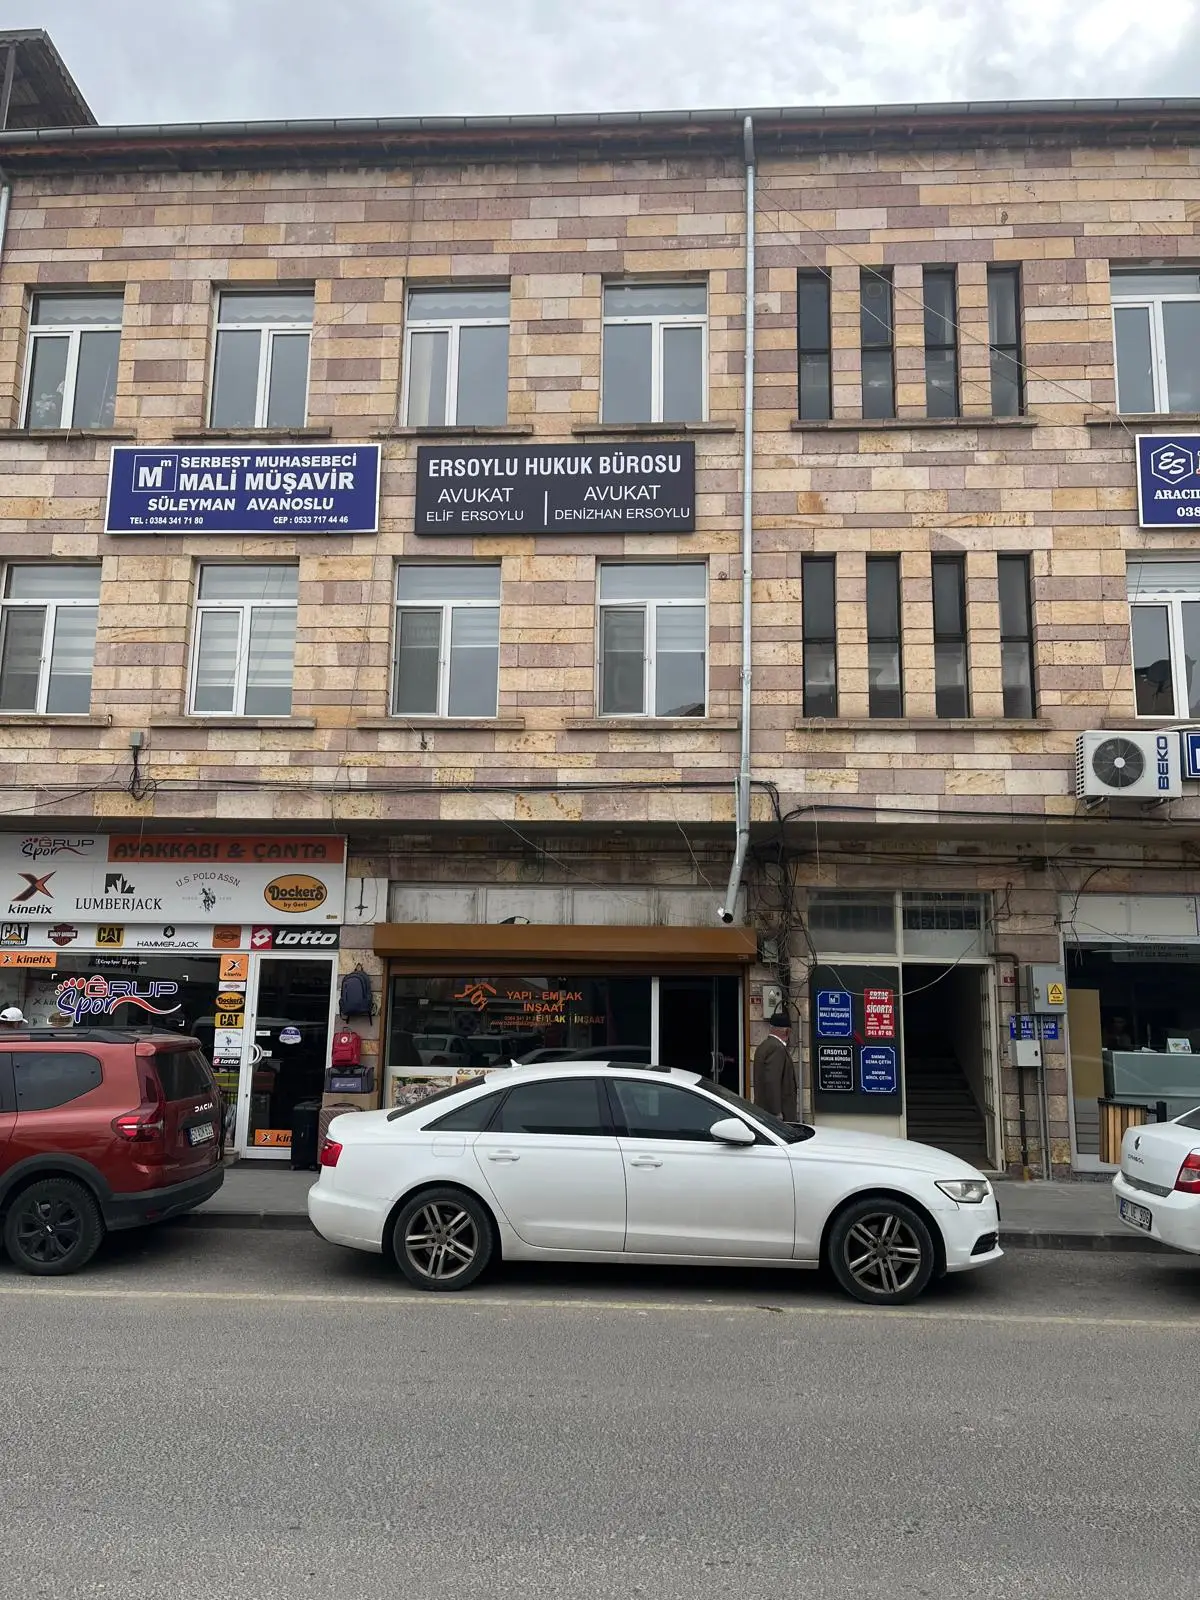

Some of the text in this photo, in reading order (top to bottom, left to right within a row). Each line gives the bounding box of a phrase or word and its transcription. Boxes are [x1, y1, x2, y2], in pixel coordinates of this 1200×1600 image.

[181, 452, 357, 468] SERBEST MUHASEBECİ
[428, 452, 681, 477] ERSOYLU HUKUK BÜROSU
[179, 468, 355, 495] MALİ MÜŞAVİR
[438, 488, 514, 504] AVUKAT
[584, 484, 661, 501] AVUKAT
[147, 496, 334, 512] SÜLEYMAN AVANOSLU
[130, 516, 144, 525] TEL
[149, 516, 168, 525] 0384
[168, 516, 182, 525] 341
[184, 516, 194, 525] 71
[194, 516, 204, 525] 80
[273, 516, 288, 524] CEP
[294, 516, 312, 524] 0533
[313, 516, 328, 524] 717
[328, 516, 338, 524] 44
[339, 516, 349, 524] 46
[426, 509, 524, 522] ELİF ERSOYLU
[554, 507, 690, 520] DENİZHAN ERSOYLU
[1156, 736, 1170, 790] BEKO
[38, 838, 95, 848] GRUP
[22, 843, 58, 860] Spor
[114, 842, 327, 861] AYAKKABI & ÇANTA
[192, 872, 216, 881] POLO
[8, 904, 52, 914] kinetix
[76, 898, 163, 912] LUMBERJACK
[2, 924, 28, 940] CAT
[97, 926, 124, 943] CAT
[275, 930, 338, 945] lotto
[136, 940, 199, 948] HAMMERJACK
[16, 954, 52, 965] kinetix
[84, 980, 178, 998] GRUP
[507, 992, 532, 1000] YAPI
[56, 987, 117, 1024] Spor
[220, 1014, 240, 1026] CAT
[194, 1102, 214, 1112] DACIA
